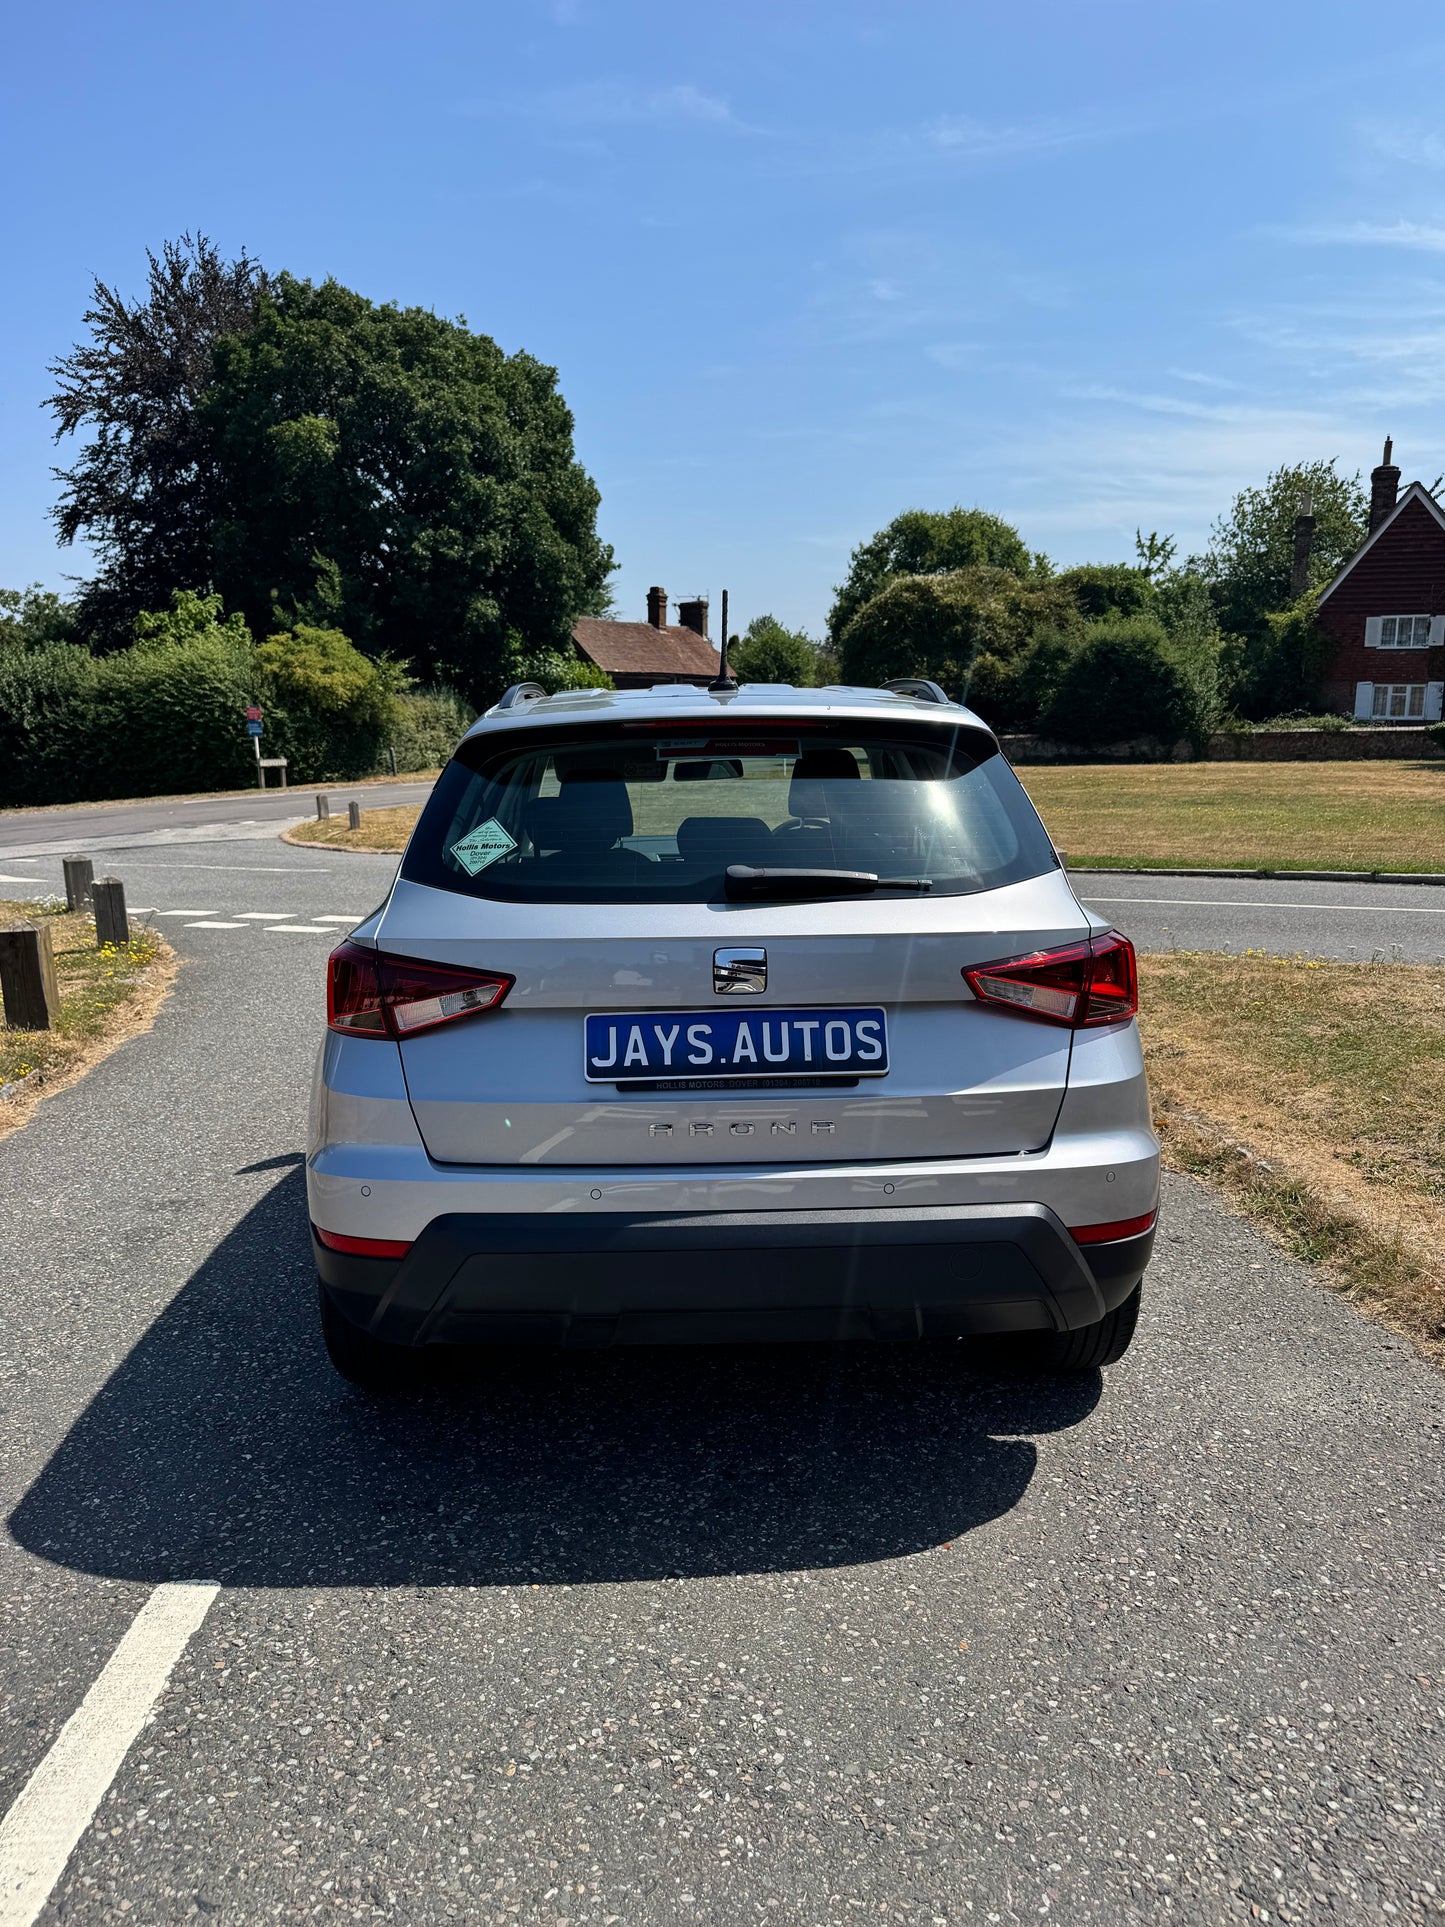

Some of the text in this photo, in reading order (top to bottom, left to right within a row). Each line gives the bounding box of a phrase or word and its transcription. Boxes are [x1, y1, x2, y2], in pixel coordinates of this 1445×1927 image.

[591, 1020, 883, 1068] JAYS.AUTOS
[656, 1081, 687, 1089] HOLLIS
[649, 1120, 836, 1137] ARONA
